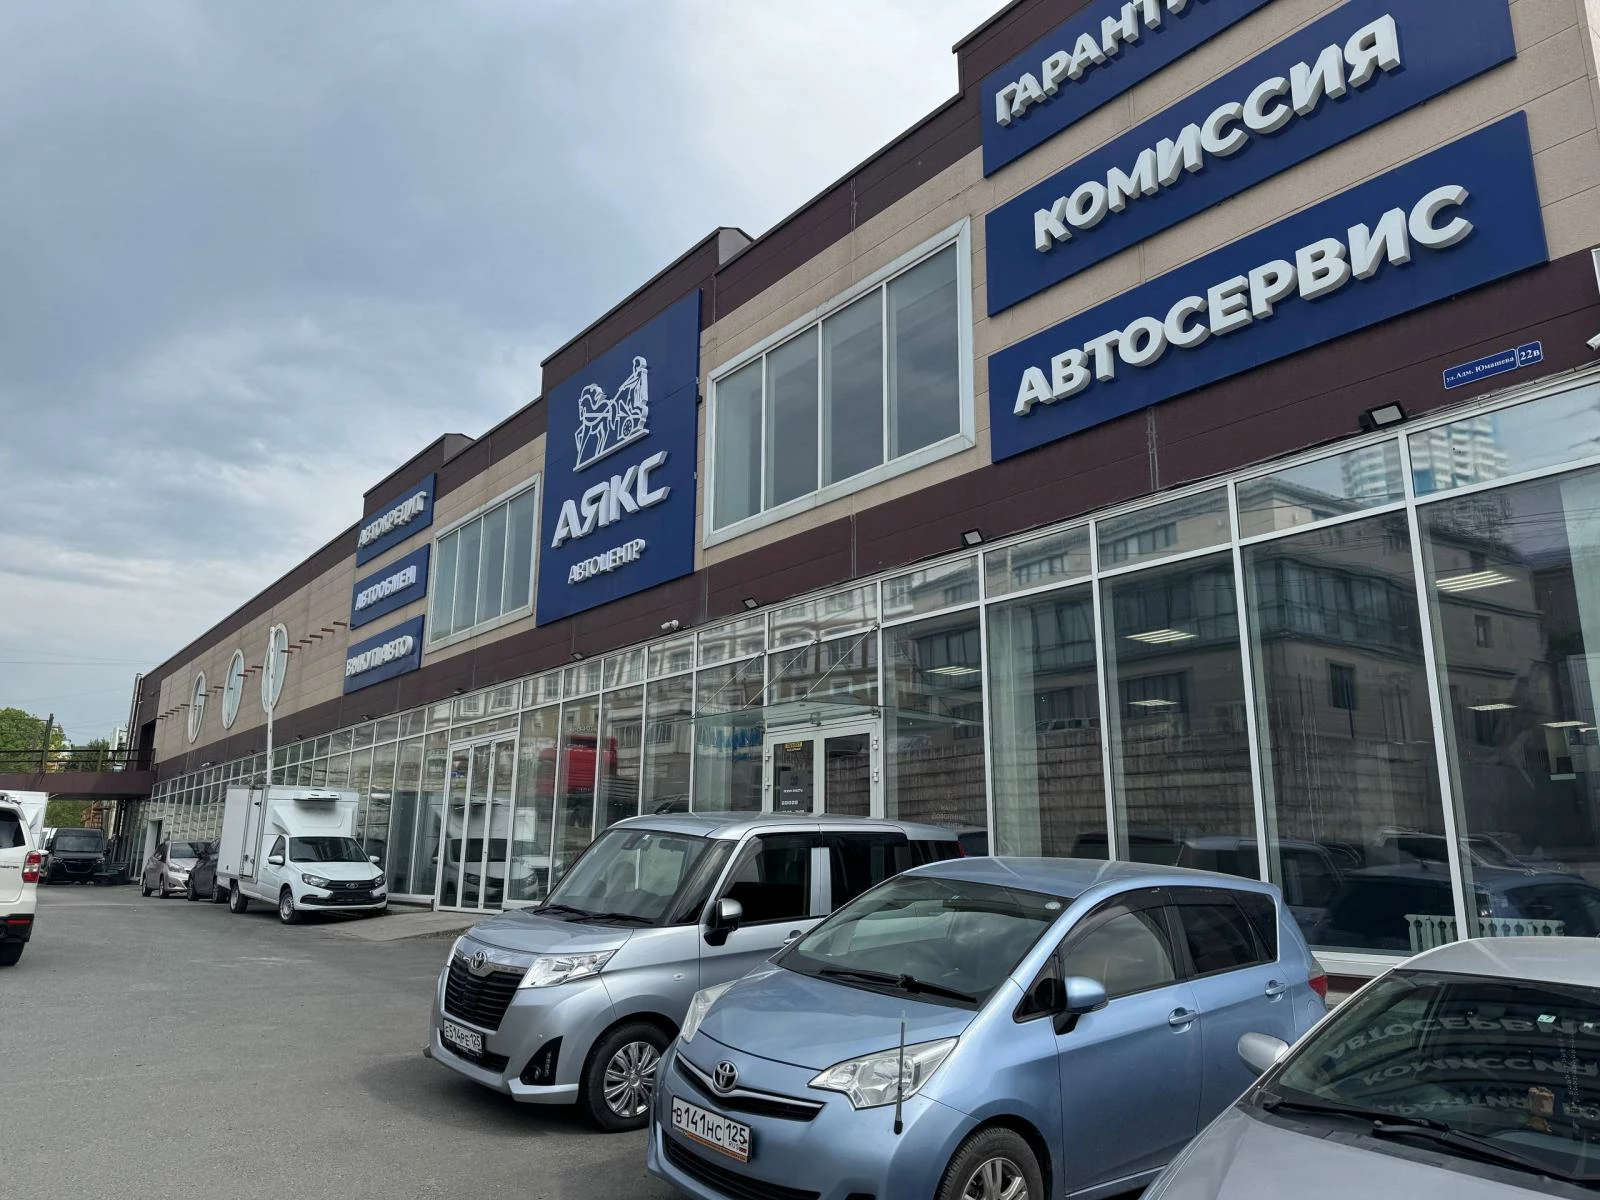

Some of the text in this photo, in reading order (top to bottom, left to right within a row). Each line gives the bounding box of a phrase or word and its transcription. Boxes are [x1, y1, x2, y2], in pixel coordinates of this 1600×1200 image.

[995, 0, 1188, 127] ГАРАНТ
[1033, 13, 1401, 253] КОМИССИЯ
[1013, 184, 1475, 416] АВТОСЕРВИС
[1475, 356, 1515, 373] Юмашева
[358, 490, 427, 549] АВТОКРЕДИТ
[551, 450, 671, 548] АЯКС
[355, 565, 416, 611] АВТООБМЕН
[567, 538, 646, 584] АВТОЦЕНТР
